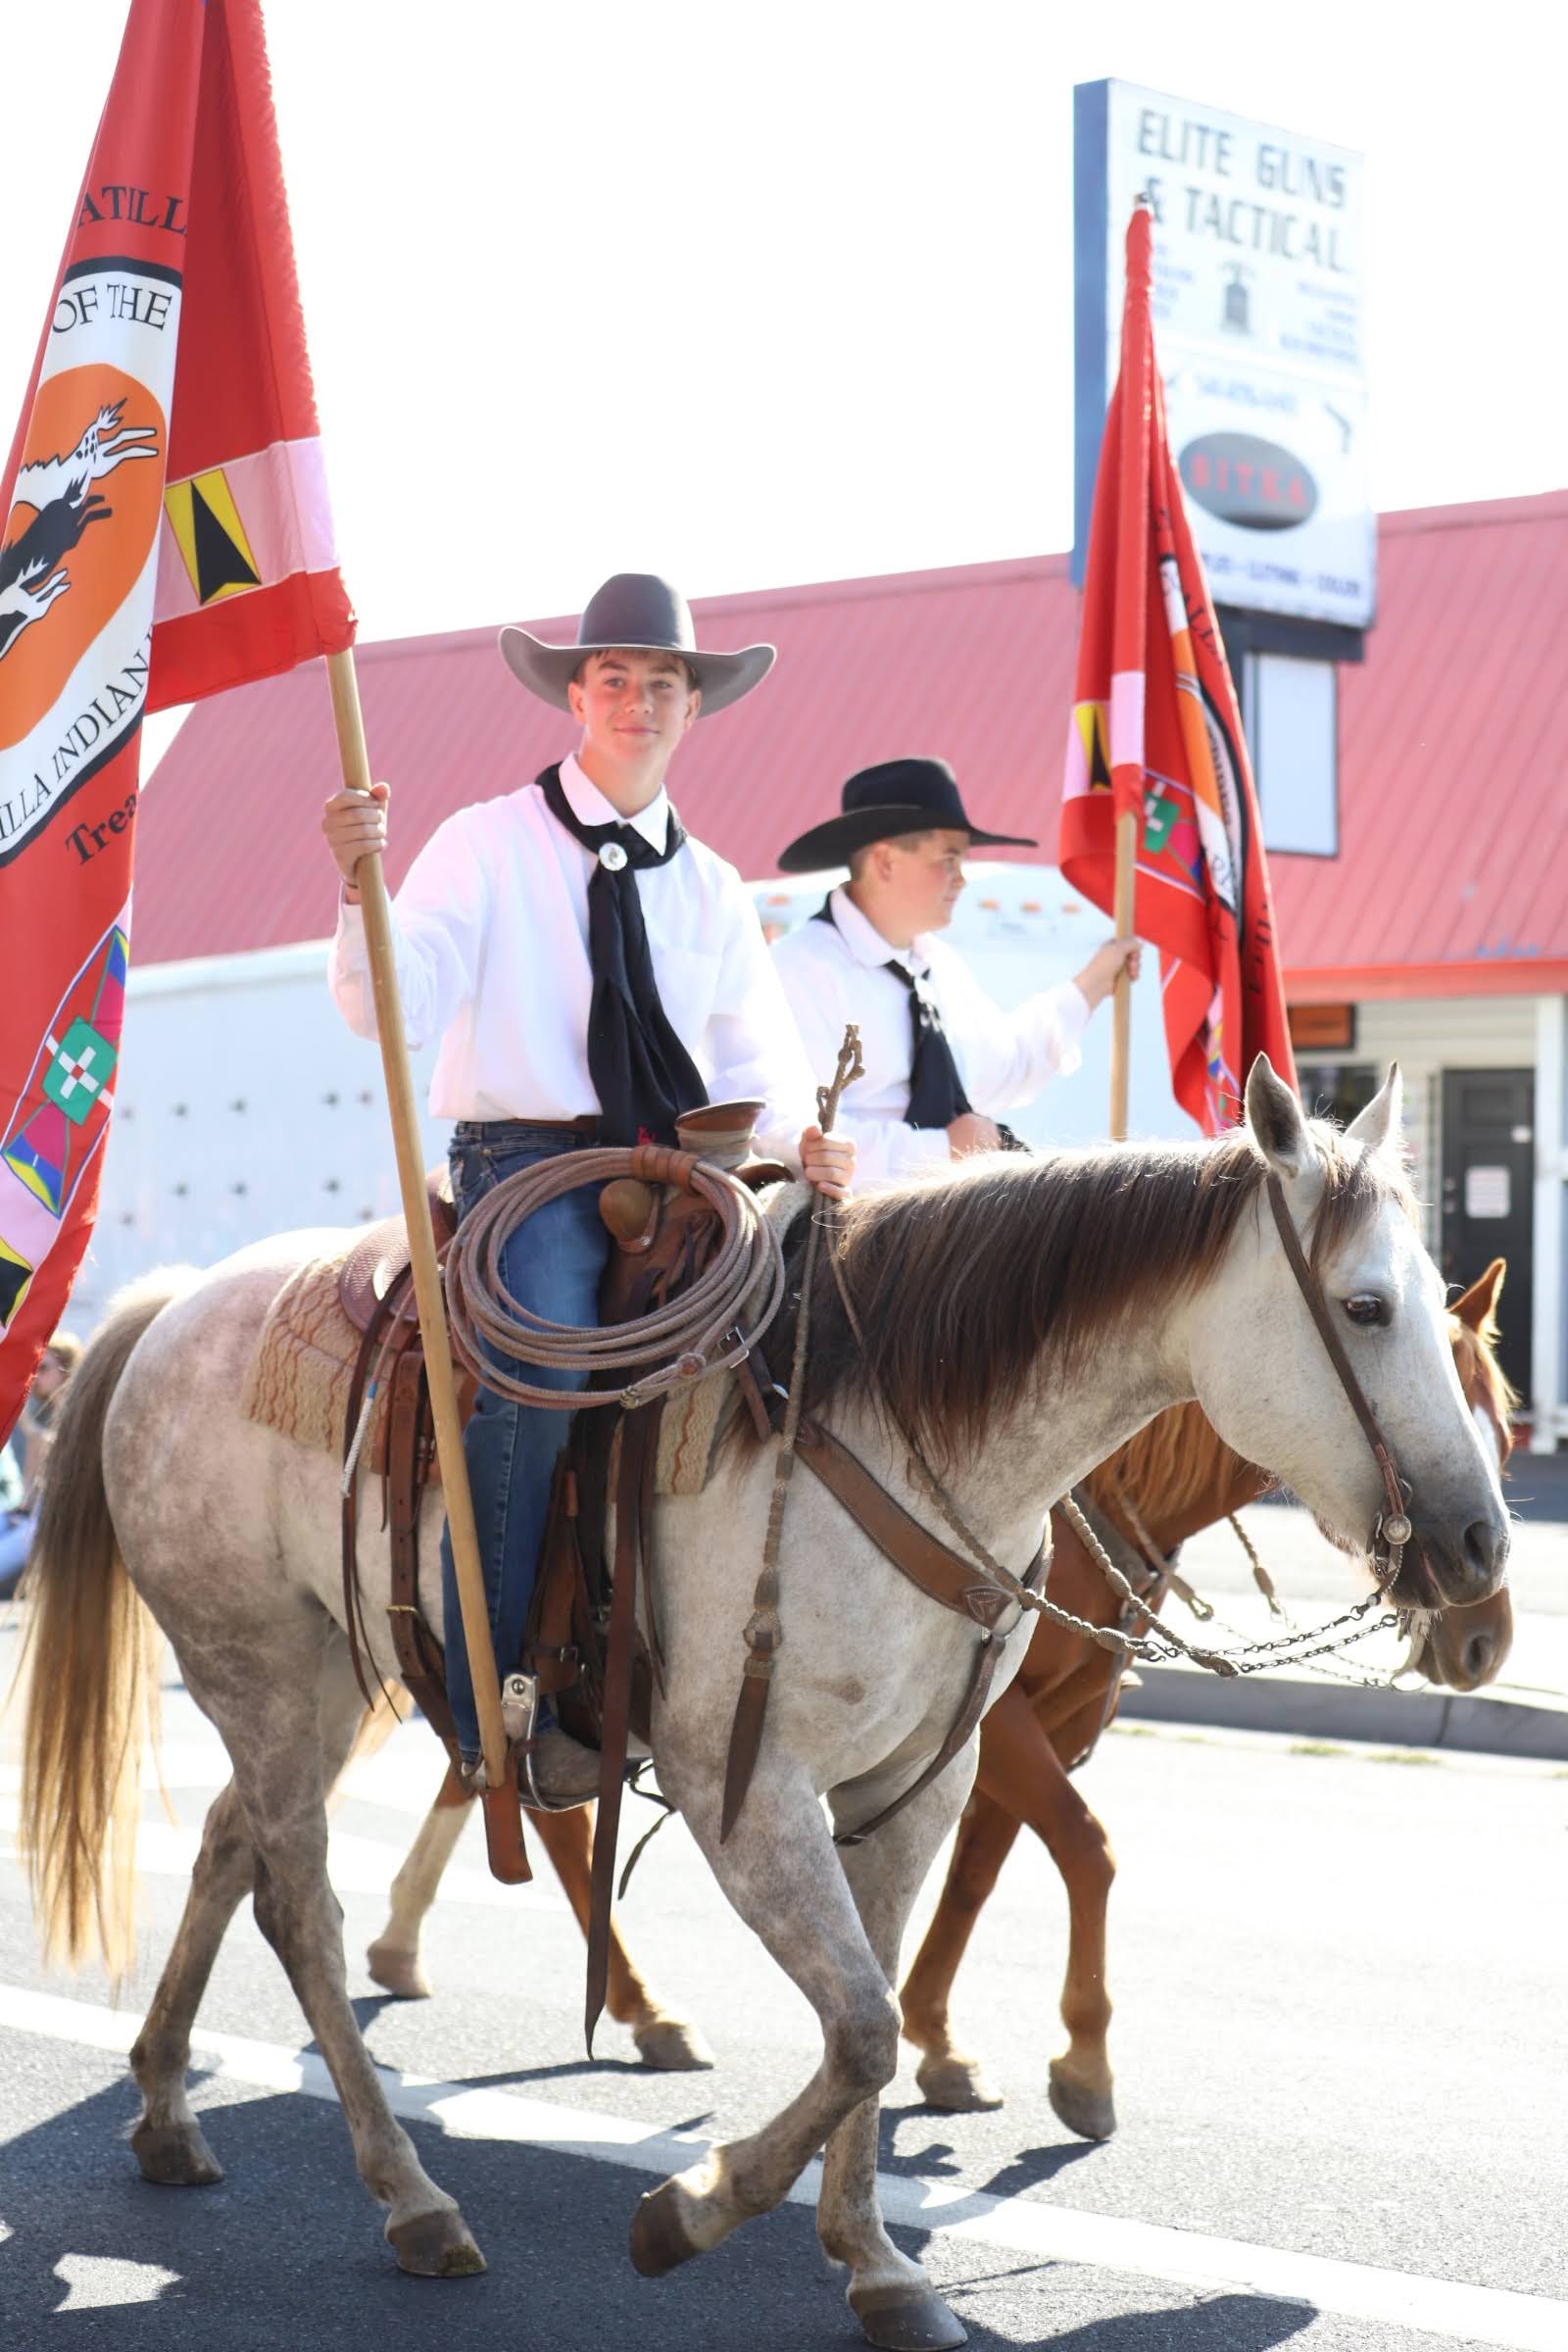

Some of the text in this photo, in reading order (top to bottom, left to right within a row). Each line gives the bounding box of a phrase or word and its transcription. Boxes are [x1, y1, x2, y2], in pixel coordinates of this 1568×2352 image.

[1138, 109, 1346, 208] ELITE GUNS
[78, 185, 186, 236] ATILL
[1185, 186, 1348, 272] TACTICAL
[52, 282, 172, 333] OF THE
[51, 649, 149, 784] INDIAN
